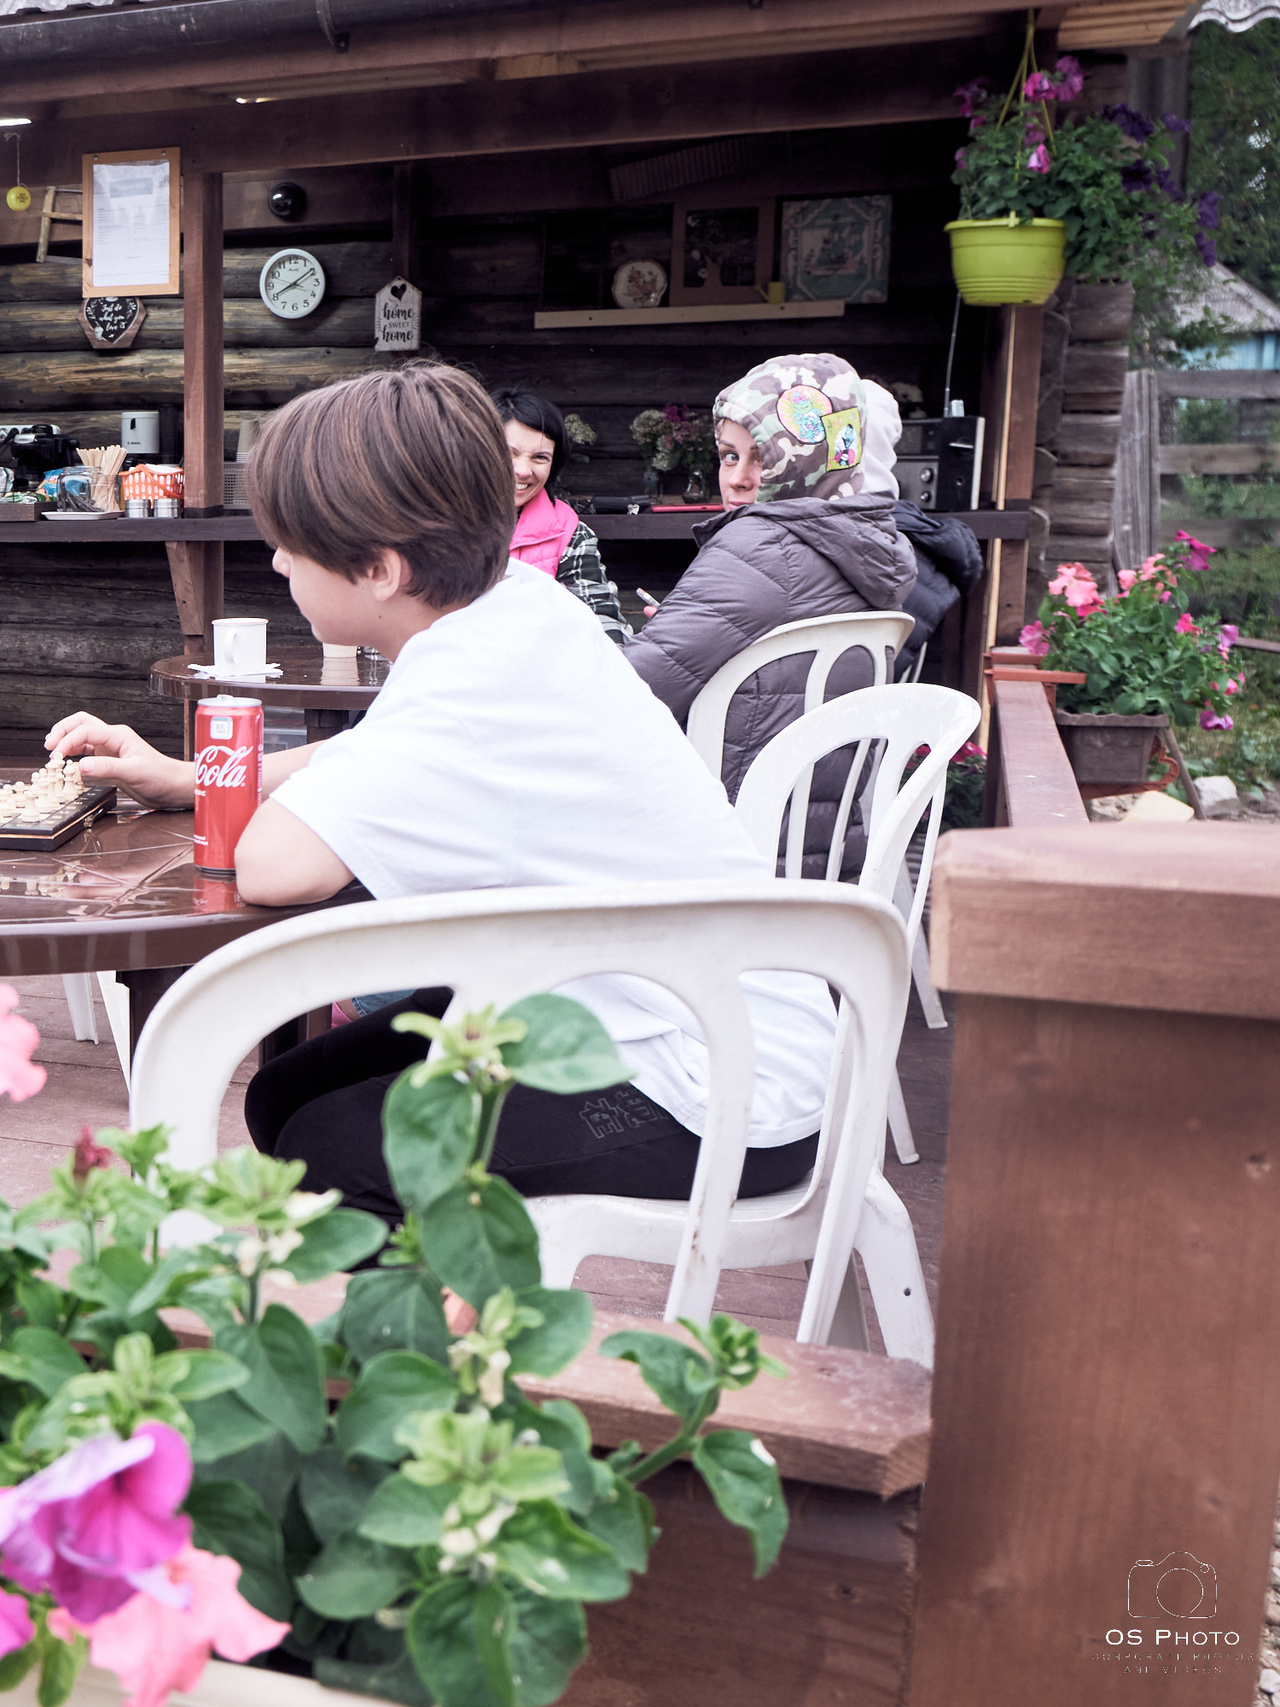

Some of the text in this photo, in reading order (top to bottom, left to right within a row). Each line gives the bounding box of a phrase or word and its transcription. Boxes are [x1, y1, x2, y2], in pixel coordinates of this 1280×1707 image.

[289, 256, 299, 264] 12
[279, 261, 286, 269] 11
[271, 270, 280, 279] 10
[268, 282, 274, 290] 9
[313, 278, 320, 287] 3
[272, 293, 279, 301] 8
[310, 290, 316, 298] 4
[281, 301, 287, 309] 7
[292, 302, 298, 311] 6
[303, 299, 310, 308] 5
[382, 303, 414, 320] home
[381, 325, 413, 342] home
